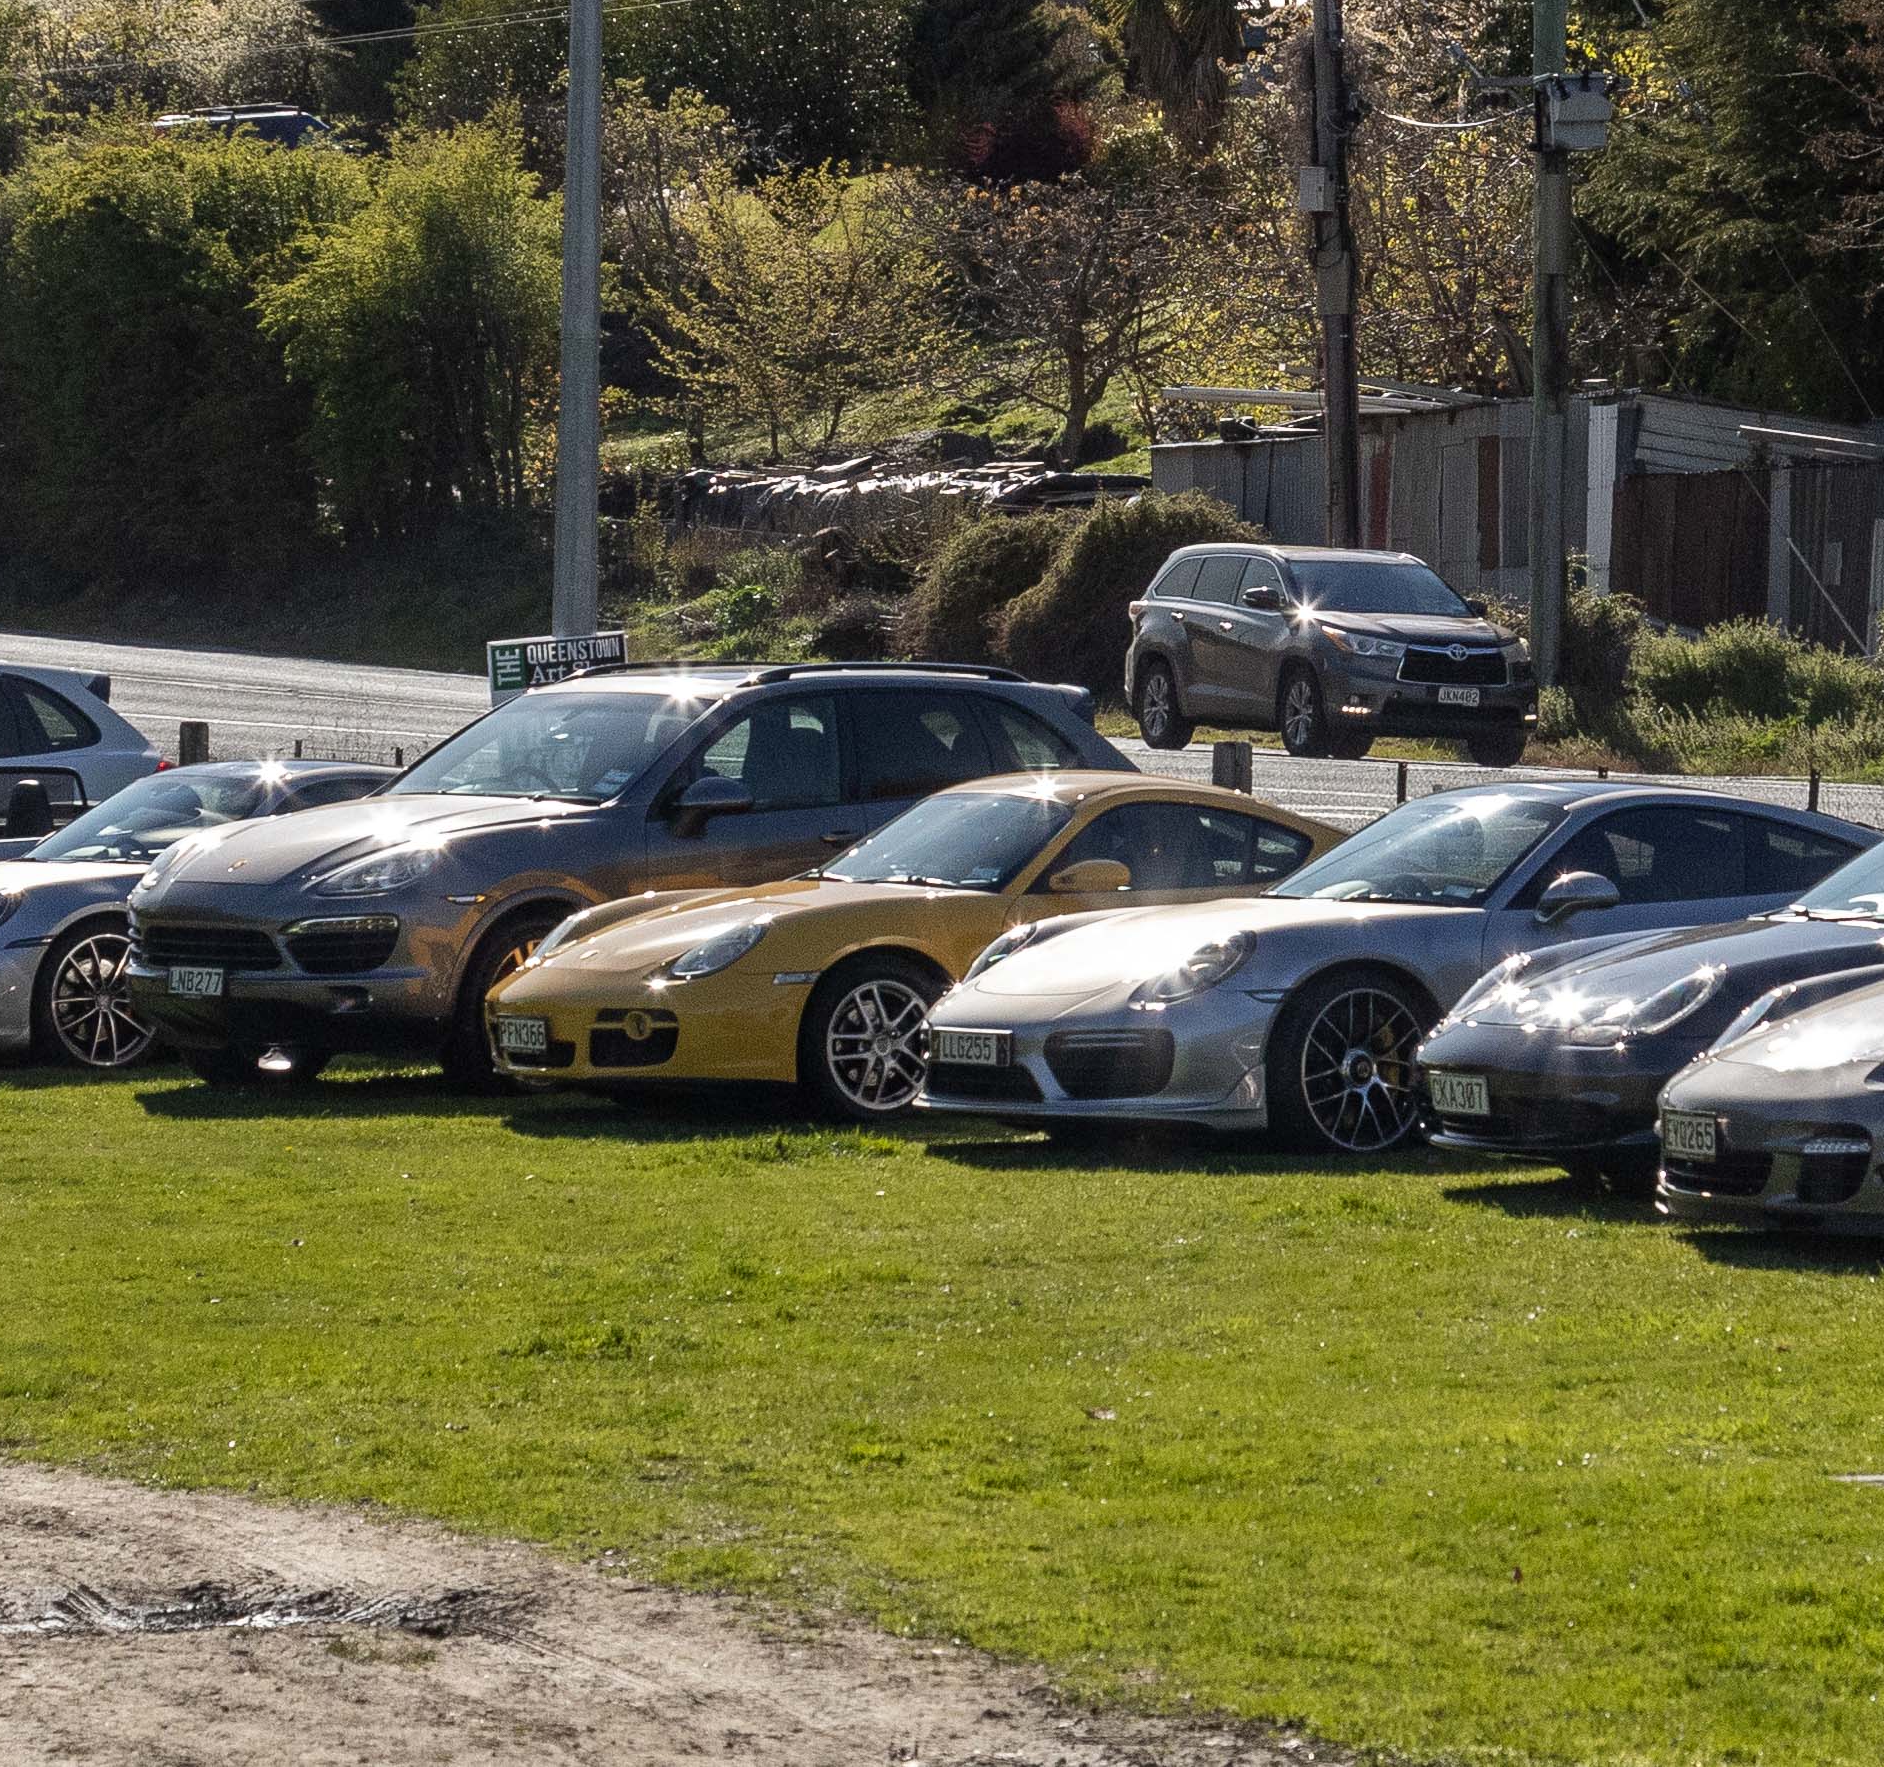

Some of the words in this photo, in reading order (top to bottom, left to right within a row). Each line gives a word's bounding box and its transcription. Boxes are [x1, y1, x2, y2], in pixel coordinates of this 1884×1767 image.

[527, 637, 620, 665] QUEENSTOWN
[496, 648, 522, 687] THE
[530, 664, 567, 684] Art
[170, 970, 221, 993] LNB277
[499, 1020, 546, 1046] PFN366
[942, 1035, 992, 1061] LLG255
[1432, 1078, 1483, 1110] CKA307
